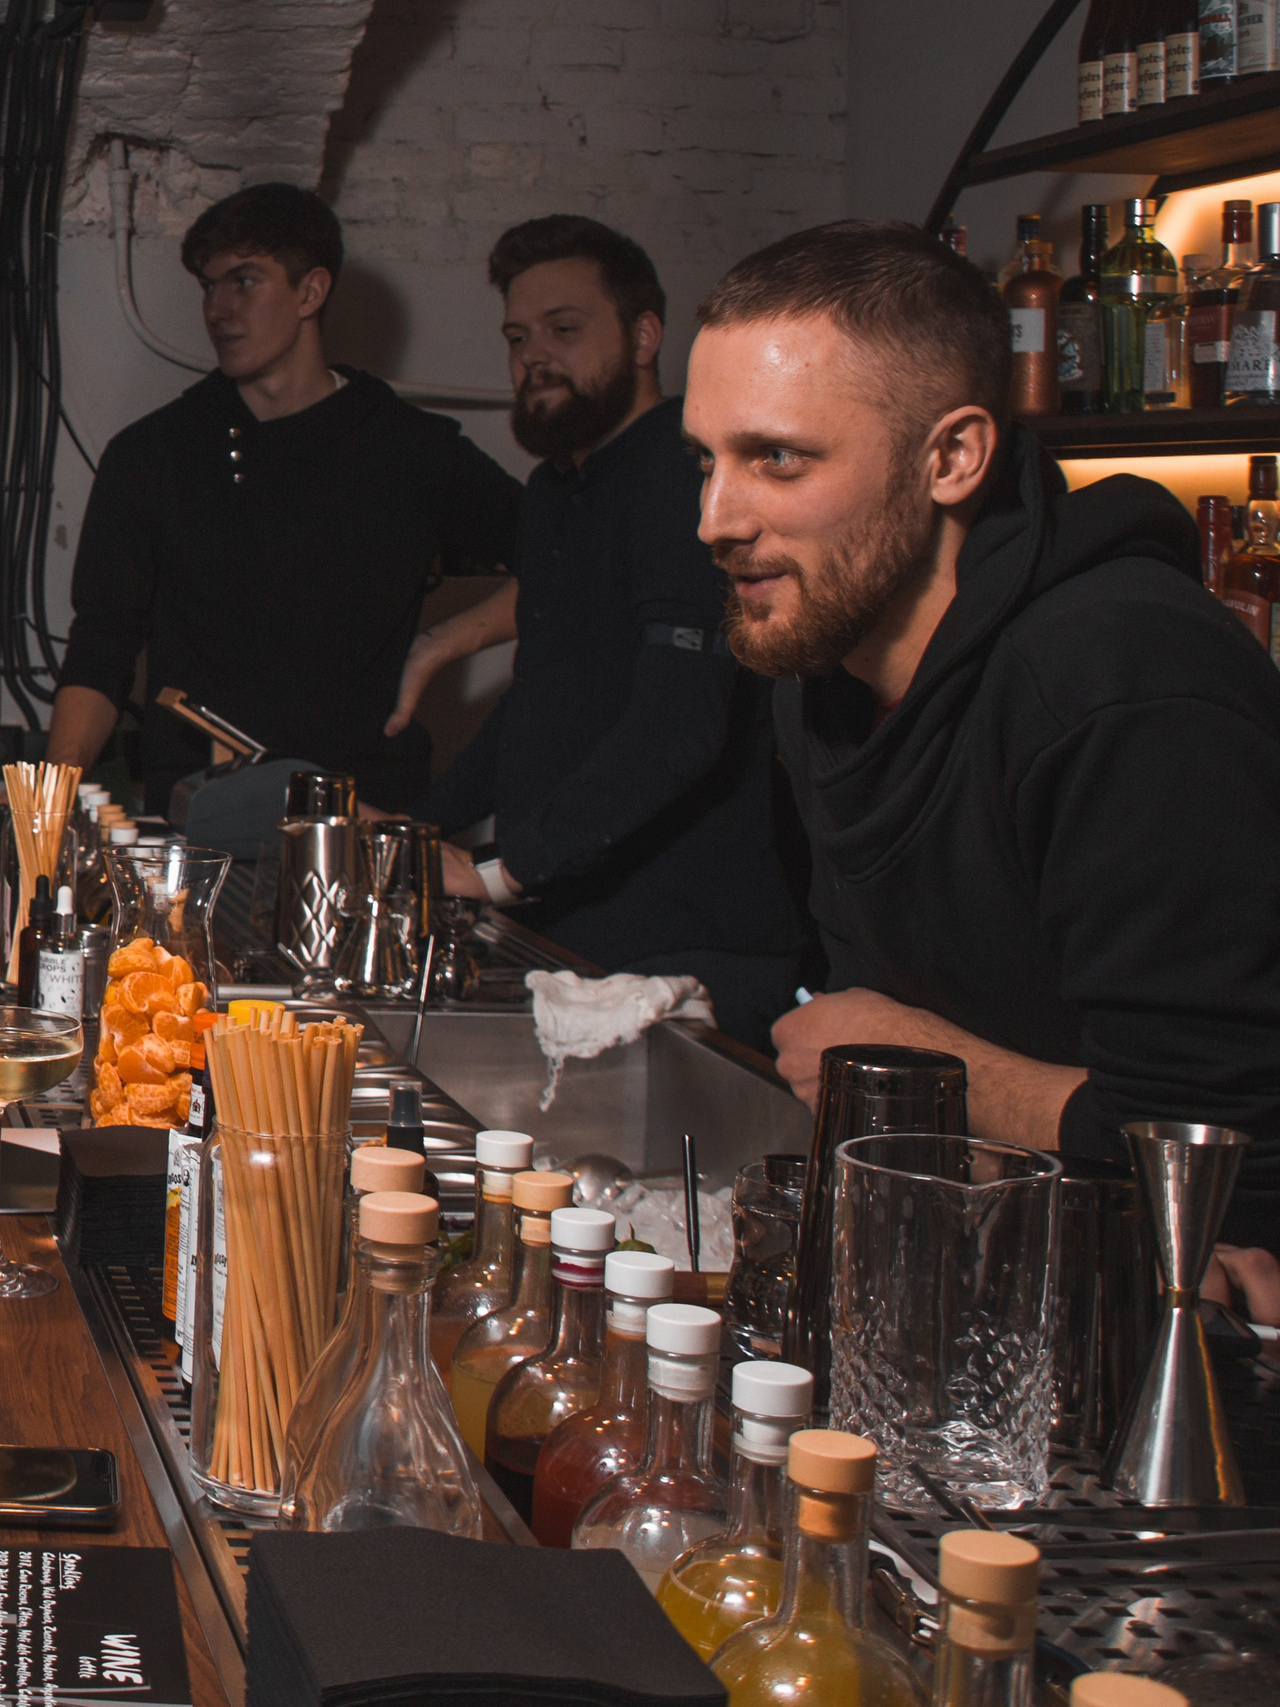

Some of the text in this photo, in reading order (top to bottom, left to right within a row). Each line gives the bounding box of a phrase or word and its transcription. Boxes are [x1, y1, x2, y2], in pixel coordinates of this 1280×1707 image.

[39, 955, 67, 966] UBBLE
[19, 1569, 32, 1582] Cava
[61, 1553, 82, 1589] Sparkling
[77, 1656, 96, 1678] bottle
[100, 1634, 142, 1683] WINE
